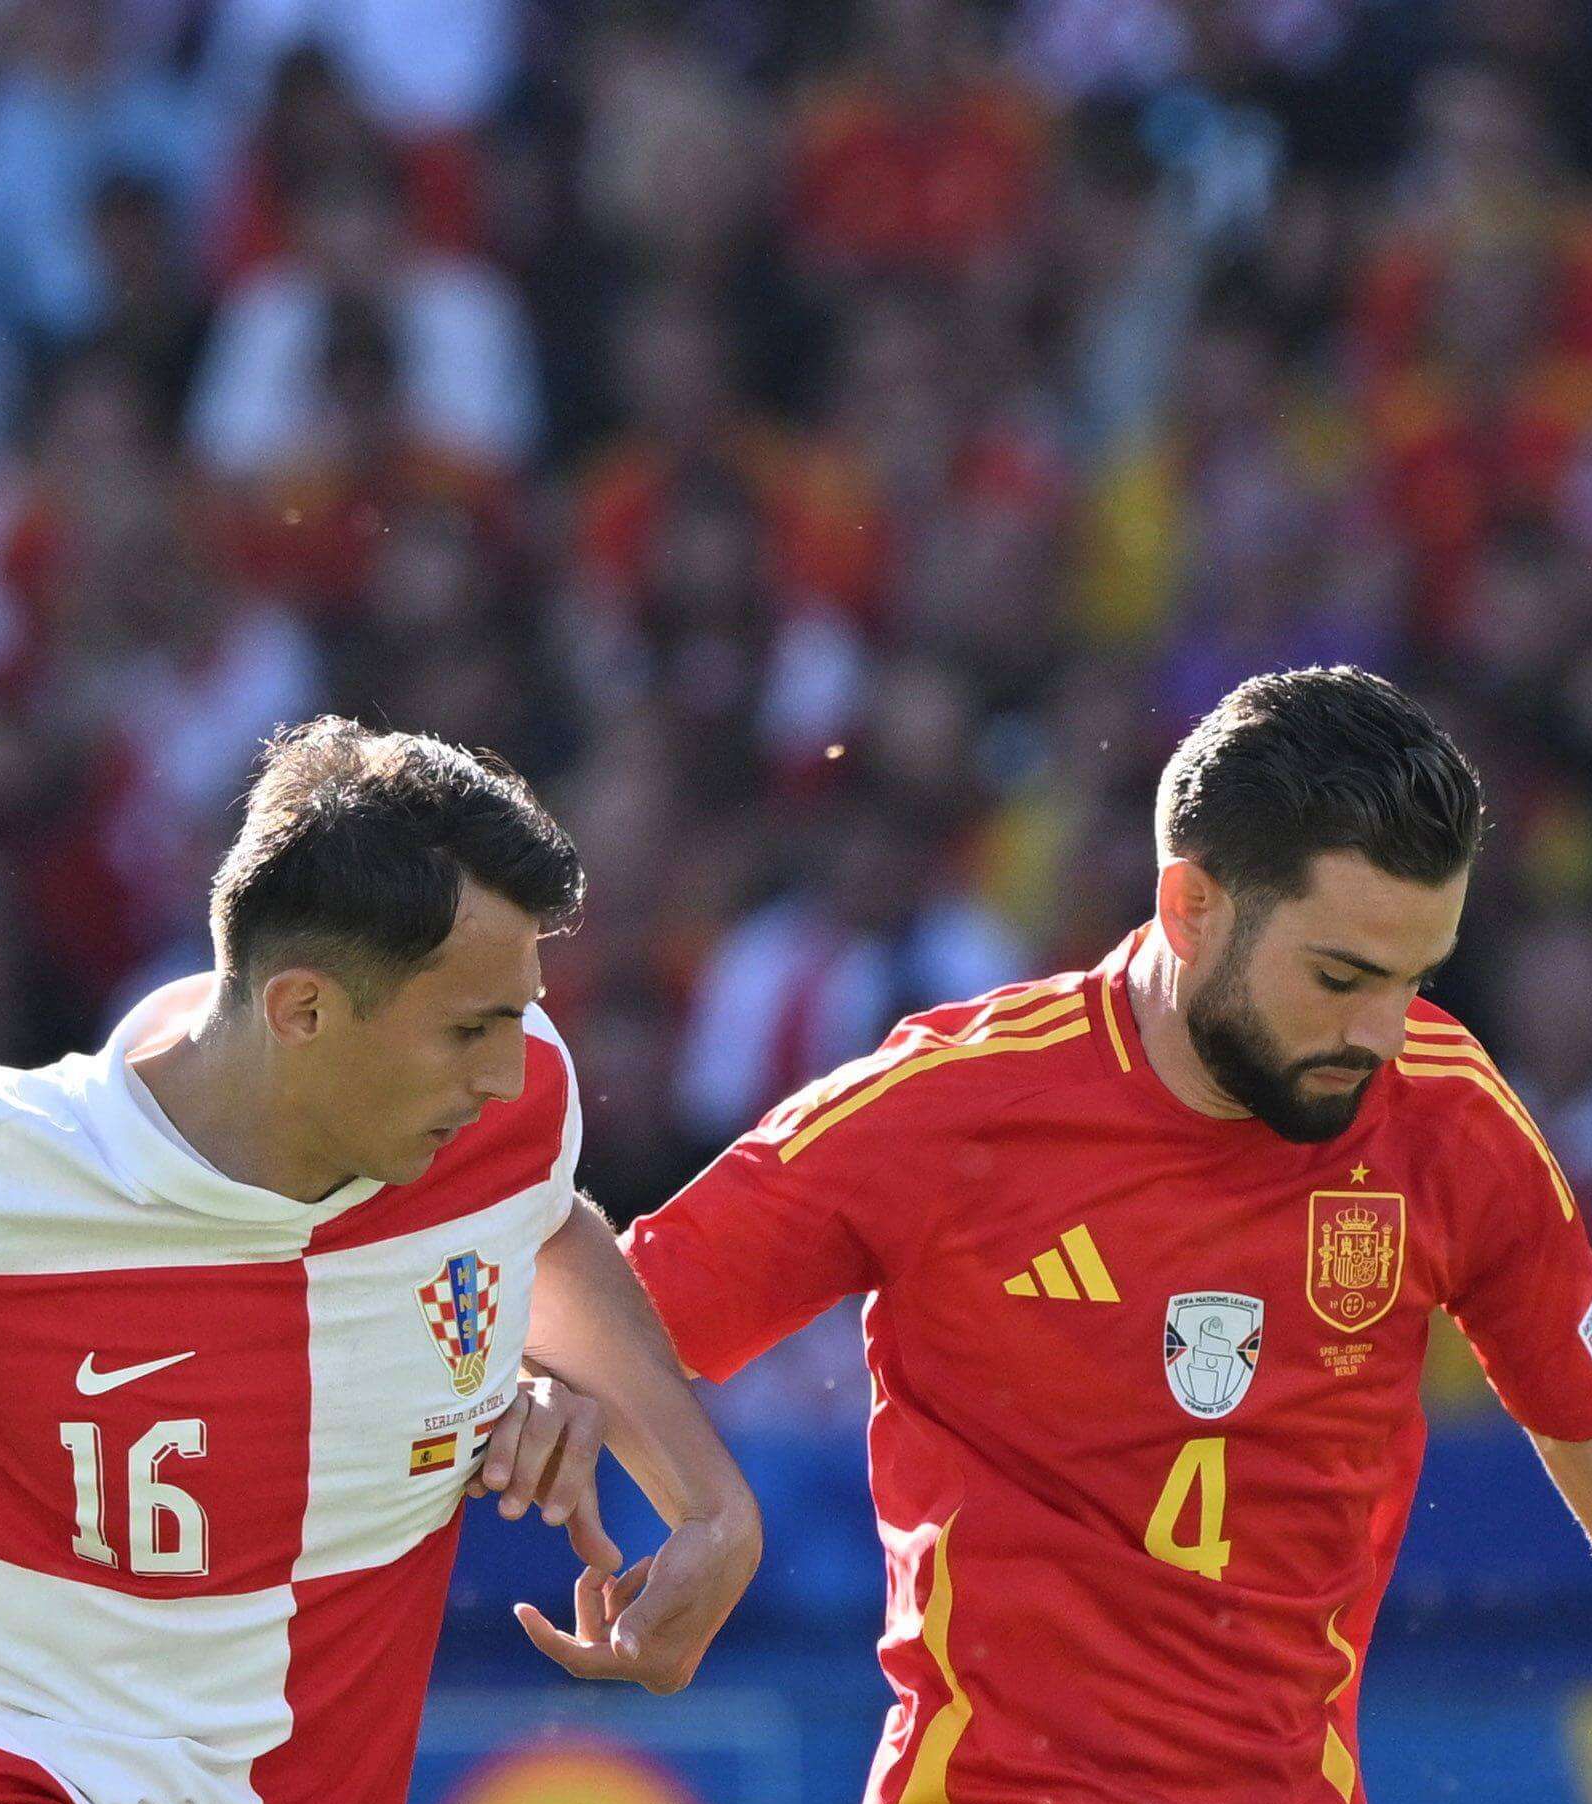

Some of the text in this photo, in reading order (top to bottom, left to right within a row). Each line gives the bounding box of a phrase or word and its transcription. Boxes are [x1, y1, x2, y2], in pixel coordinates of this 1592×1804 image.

[456, 1266, 476, 1340] HNS
[1173, 1295, 1259, 1310] UEFA NATIONS LEAGUE
[424, 1411, 465, 1432] BERLIN
[59, 1418, 210, 1578] 16
[1144, 1437, 1231, 1582] 4
